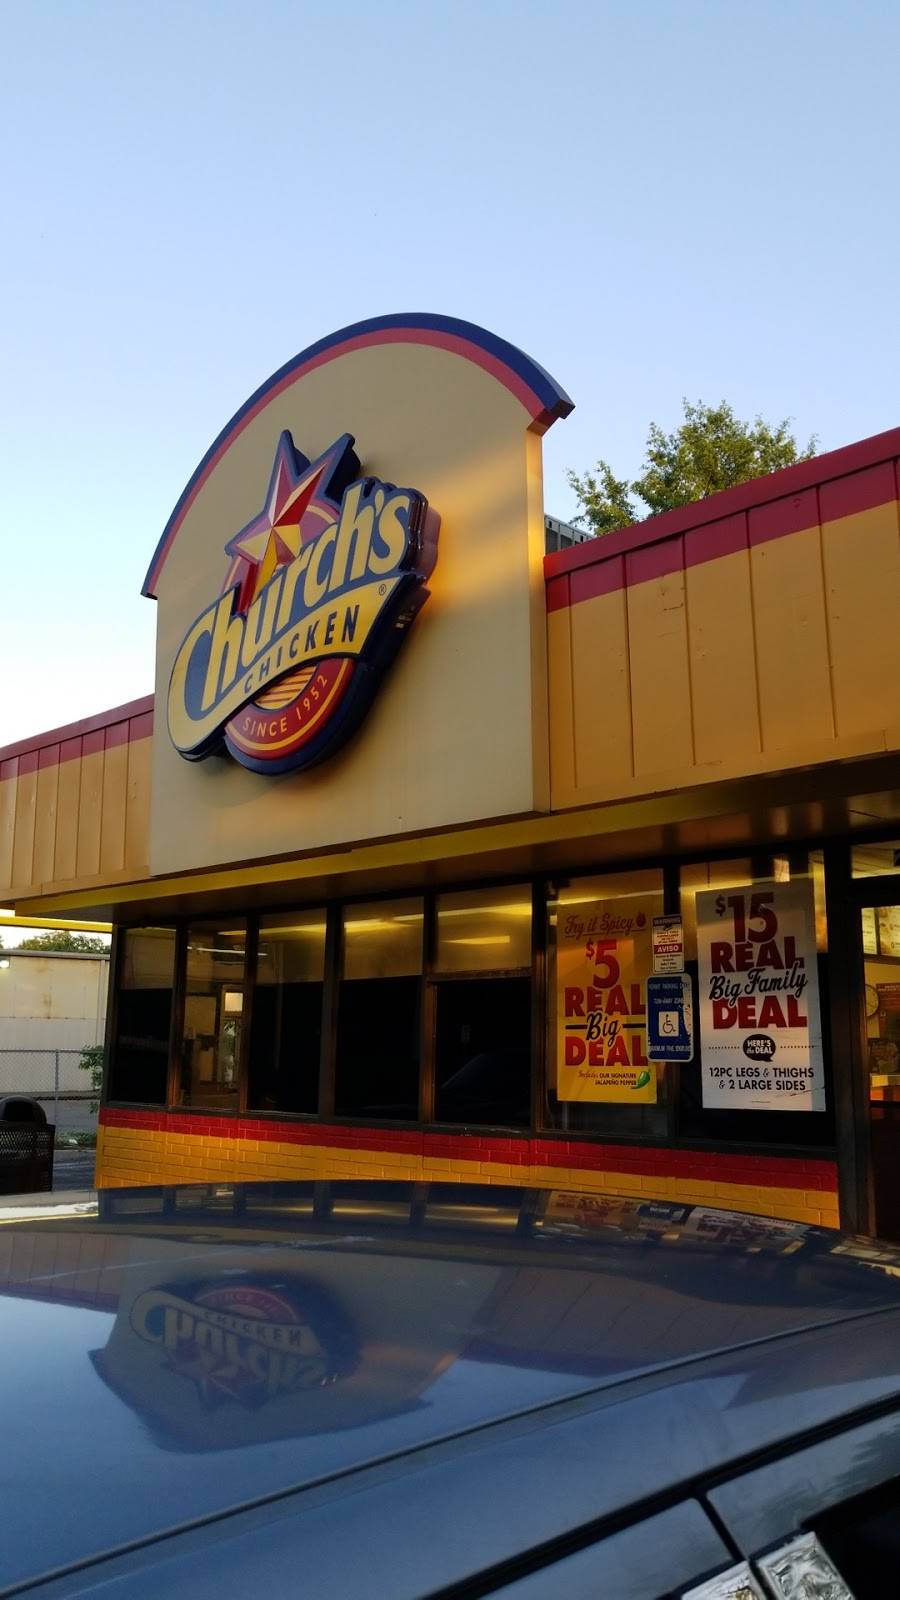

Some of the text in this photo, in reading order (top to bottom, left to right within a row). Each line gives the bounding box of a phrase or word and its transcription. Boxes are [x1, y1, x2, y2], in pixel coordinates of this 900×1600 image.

[168, 482, 411, 752] Church's
[244, 604, 360, 694] CHICKEN
[243, 674, 329, 737] SINCE 1952
[564, 914, 584, 940] Try
[600, 911, 635, 936] Spicy
[715, 892, 778, 943] $15
[585, 938, 621, 989] $5
[657, 944, 679, 953] AVISO
[710, 936, 804, 974] REAL
[564, 983, 646, 1018] REAL
[709, 960, 808, 1007] Big Family
[585, 1011, 621, 1046] Big
[712, 994, 808, 1030] DEAL
[564, 1034, 648, 1067] DEAL
[747, 1039, 771, 1047] HERE'S
[755, 1046, 773, 1054] DEAL
[709, 1067, 733, 1078] 12PC
[735, 1067, 760, 1078] LEGS
[772, 1067, 814, 1078] THIGHS
[729, 1079, 736, 1089] 2
[738, 1079, 772, 1090] LARGE
[775, 1079, 806, 1091] SIDES
